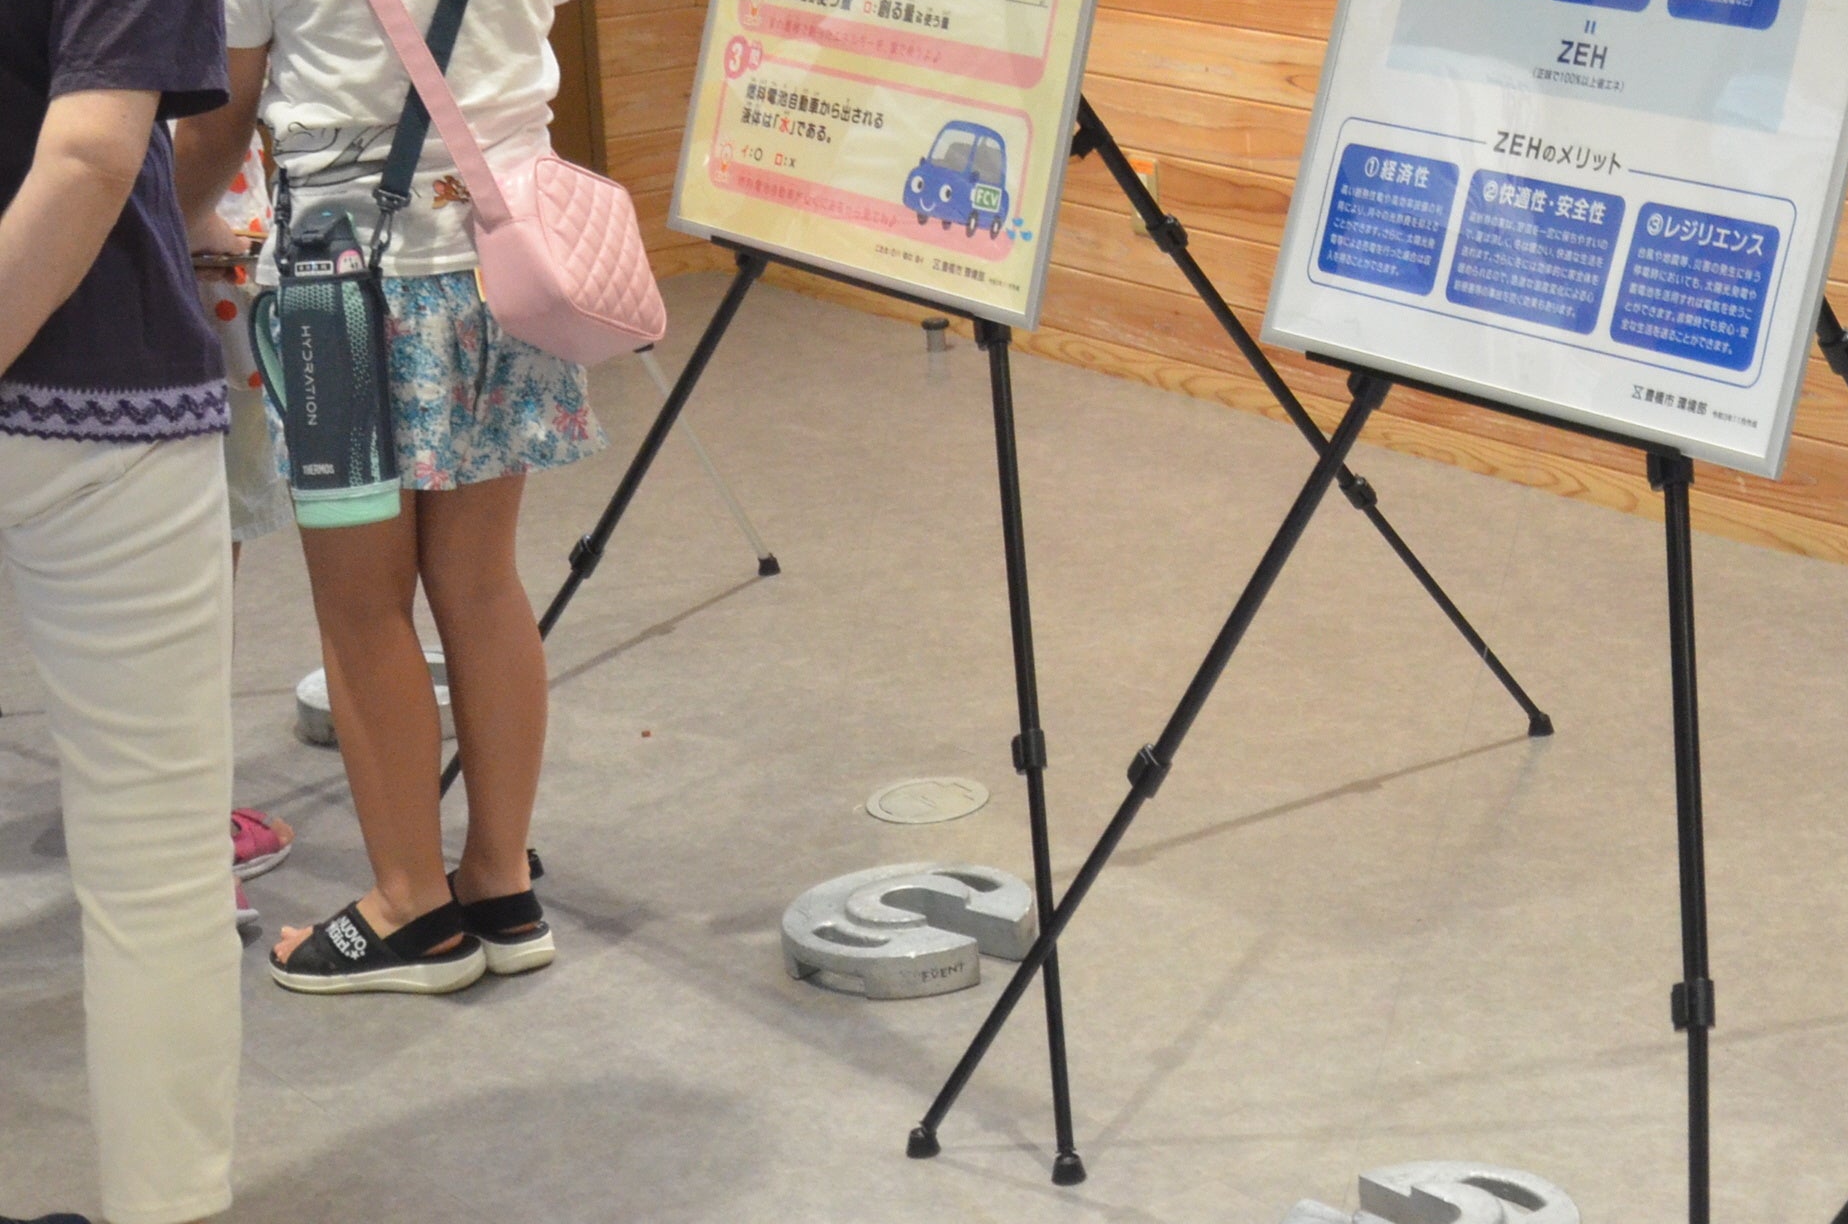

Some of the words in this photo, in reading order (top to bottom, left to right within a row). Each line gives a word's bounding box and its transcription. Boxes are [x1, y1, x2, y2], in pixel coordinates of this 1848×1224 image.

[1557, 39, 1609, 69] ZEH
[1493, 130, 1622, 175] ZEHのメリット
[974, 188, 999, 208] FCV
[301, 325, 318, 427] HYDRATION
